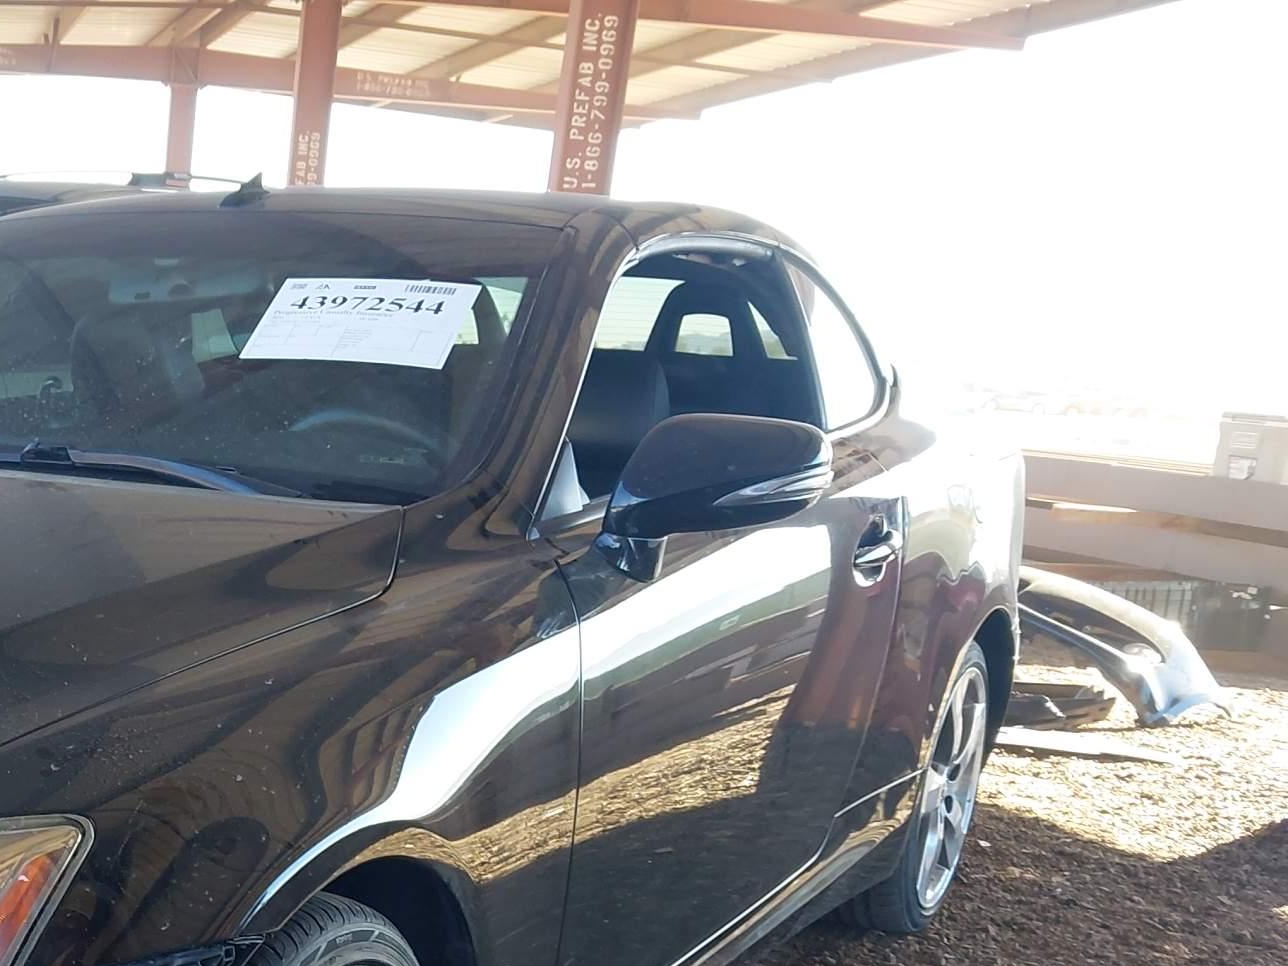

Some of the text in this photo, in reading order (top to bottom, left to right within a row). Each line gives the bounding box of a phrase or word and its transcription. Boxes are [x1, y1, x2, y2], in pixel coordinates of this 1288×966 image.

[563, 13, 602, 189] U.S. PREFAB INC.
[581, 15, 619, 189] 1-866-799-0969
[290, 295, 446, 315] 43972544
